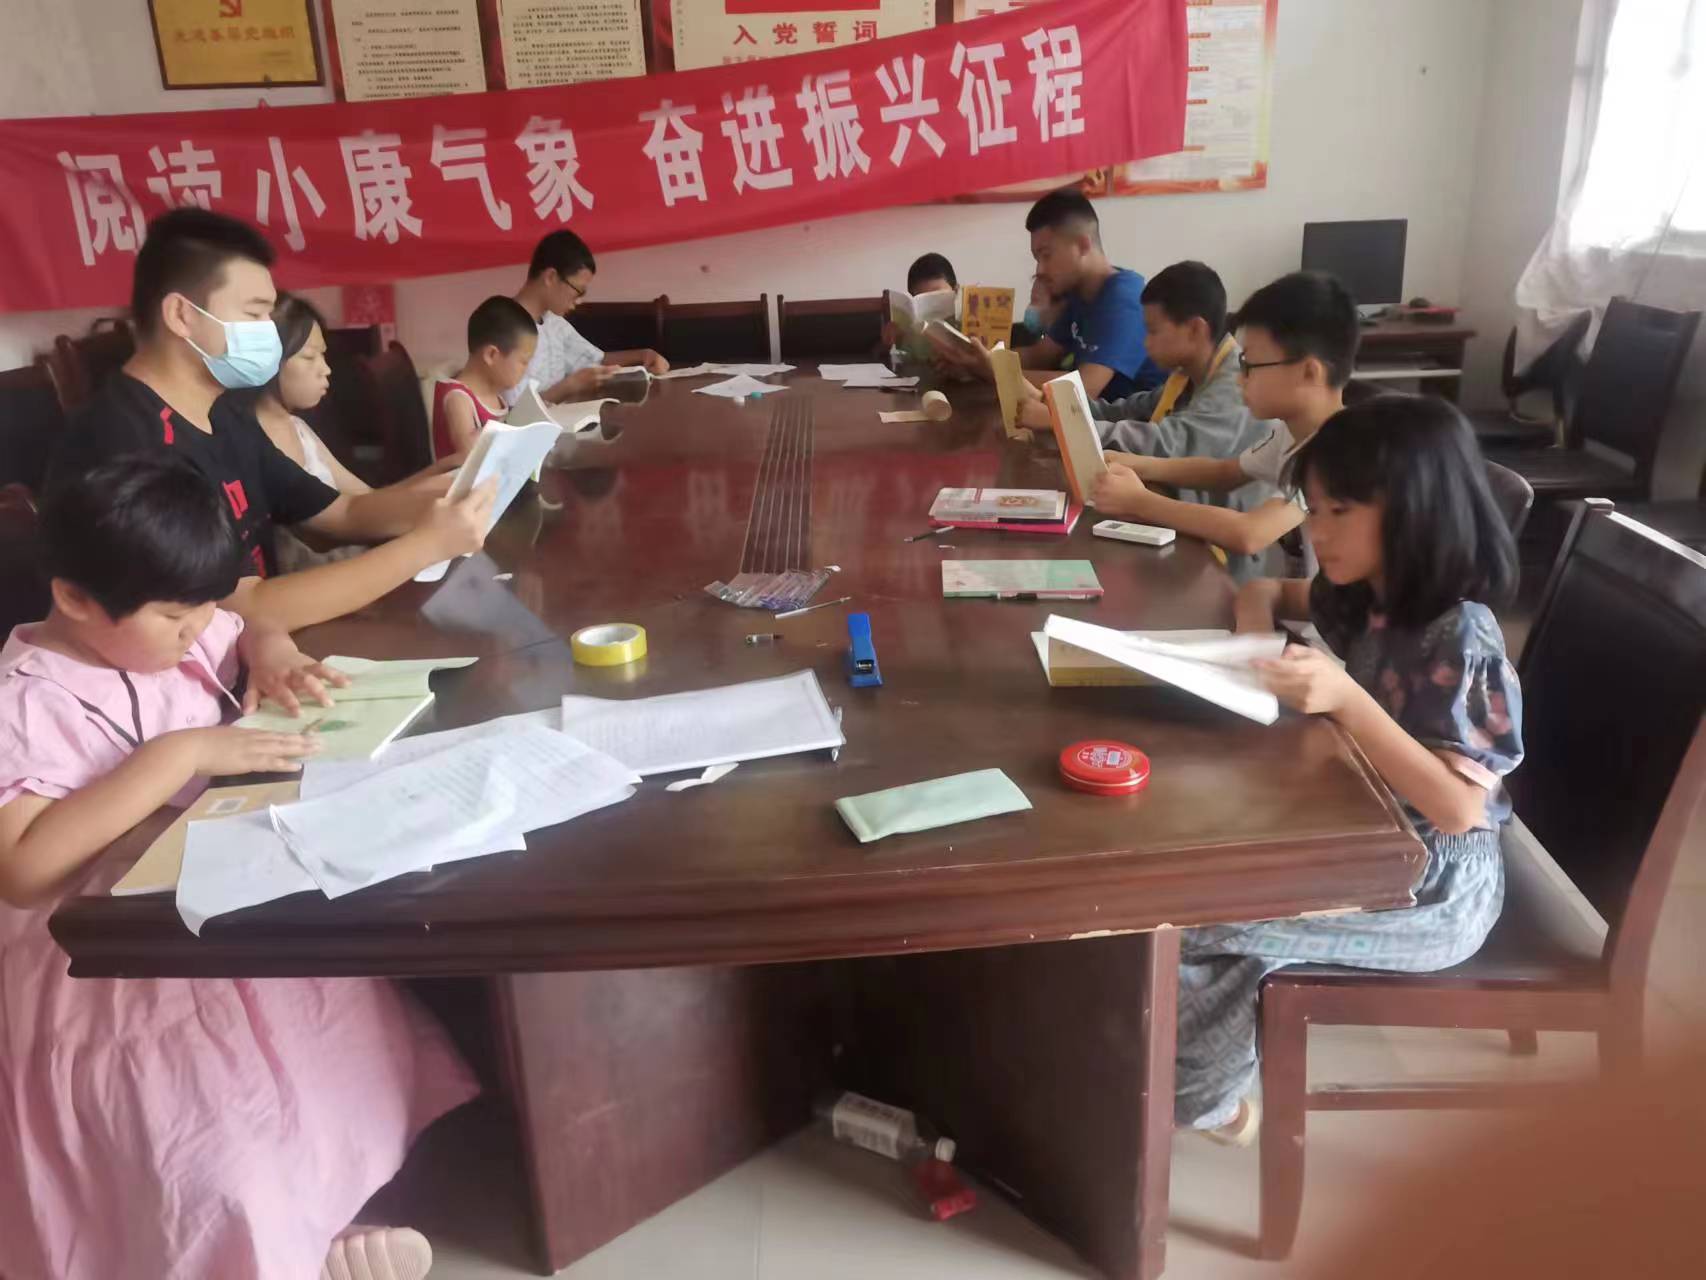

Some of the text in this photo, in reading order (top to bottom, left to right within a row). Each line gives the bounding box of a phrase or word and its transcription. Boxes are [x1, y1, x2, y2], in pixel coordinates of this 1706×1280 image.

[733, 20, 878, 45] 入党誓词
[57, 115, 595, 266] 阅读小康气象
[638, 23, 1086, 207] 奋进振兴征程
